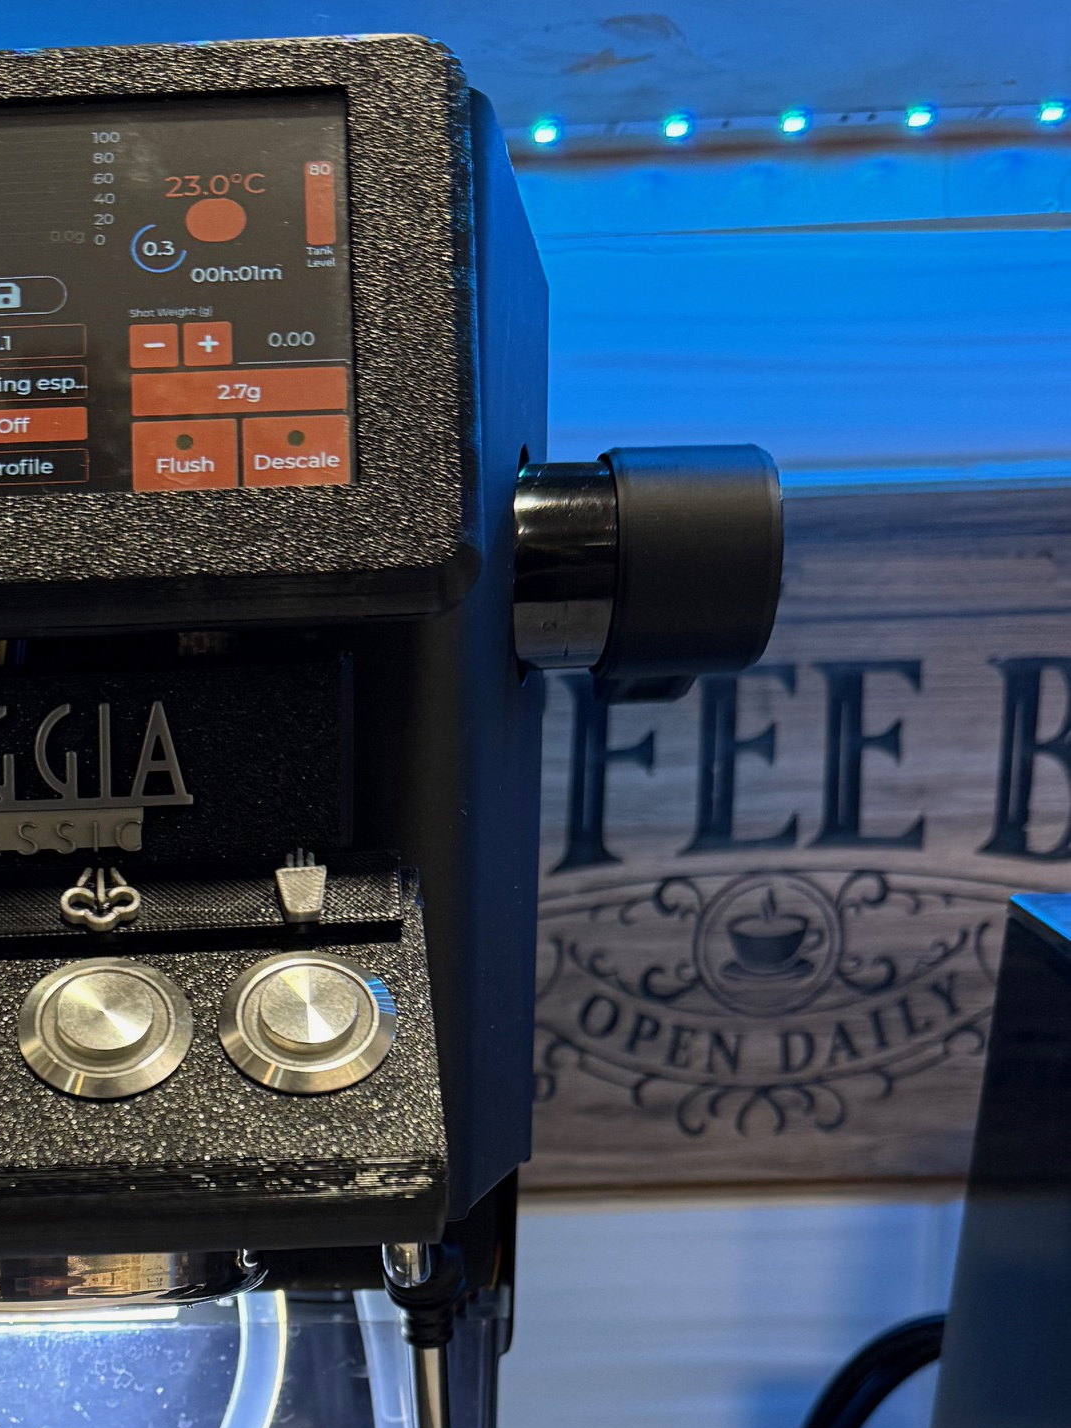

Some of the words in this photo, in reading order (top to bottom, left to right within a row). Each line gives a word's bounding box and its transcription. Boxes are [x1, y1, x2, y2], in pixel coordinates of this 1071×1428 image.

[91, 131, 120, 144] 100
[93, 152, 114, 164] 80
[308, 164, 331, 176] 80
[93, 172, 114, 185] 60
[164, 173, 266, 199] 23.0°C
[93, 192, 116, 205] 40
[94, 213, 114, 225] 20
[94, 234, 106, 246] 0
[142, 240, 175, 256] 0.3
[305, 246, 334, 255] Tank
[306, 257, 336, 267] Level
[191, 264, 283, 283] 00h:01m
[129, 308, 155, 318] Shot
[157, 307, 196, 318] Weight
[267, 331, 316, 347] 0.00
[217, 384, 261, 402] 2.7g
[156, 456, 215, 474] Flush
[253, 452, 340, 471] Descale
[578, 994, 743, 1074] OPEN
[776, 972, 959, 1075] DAILY
